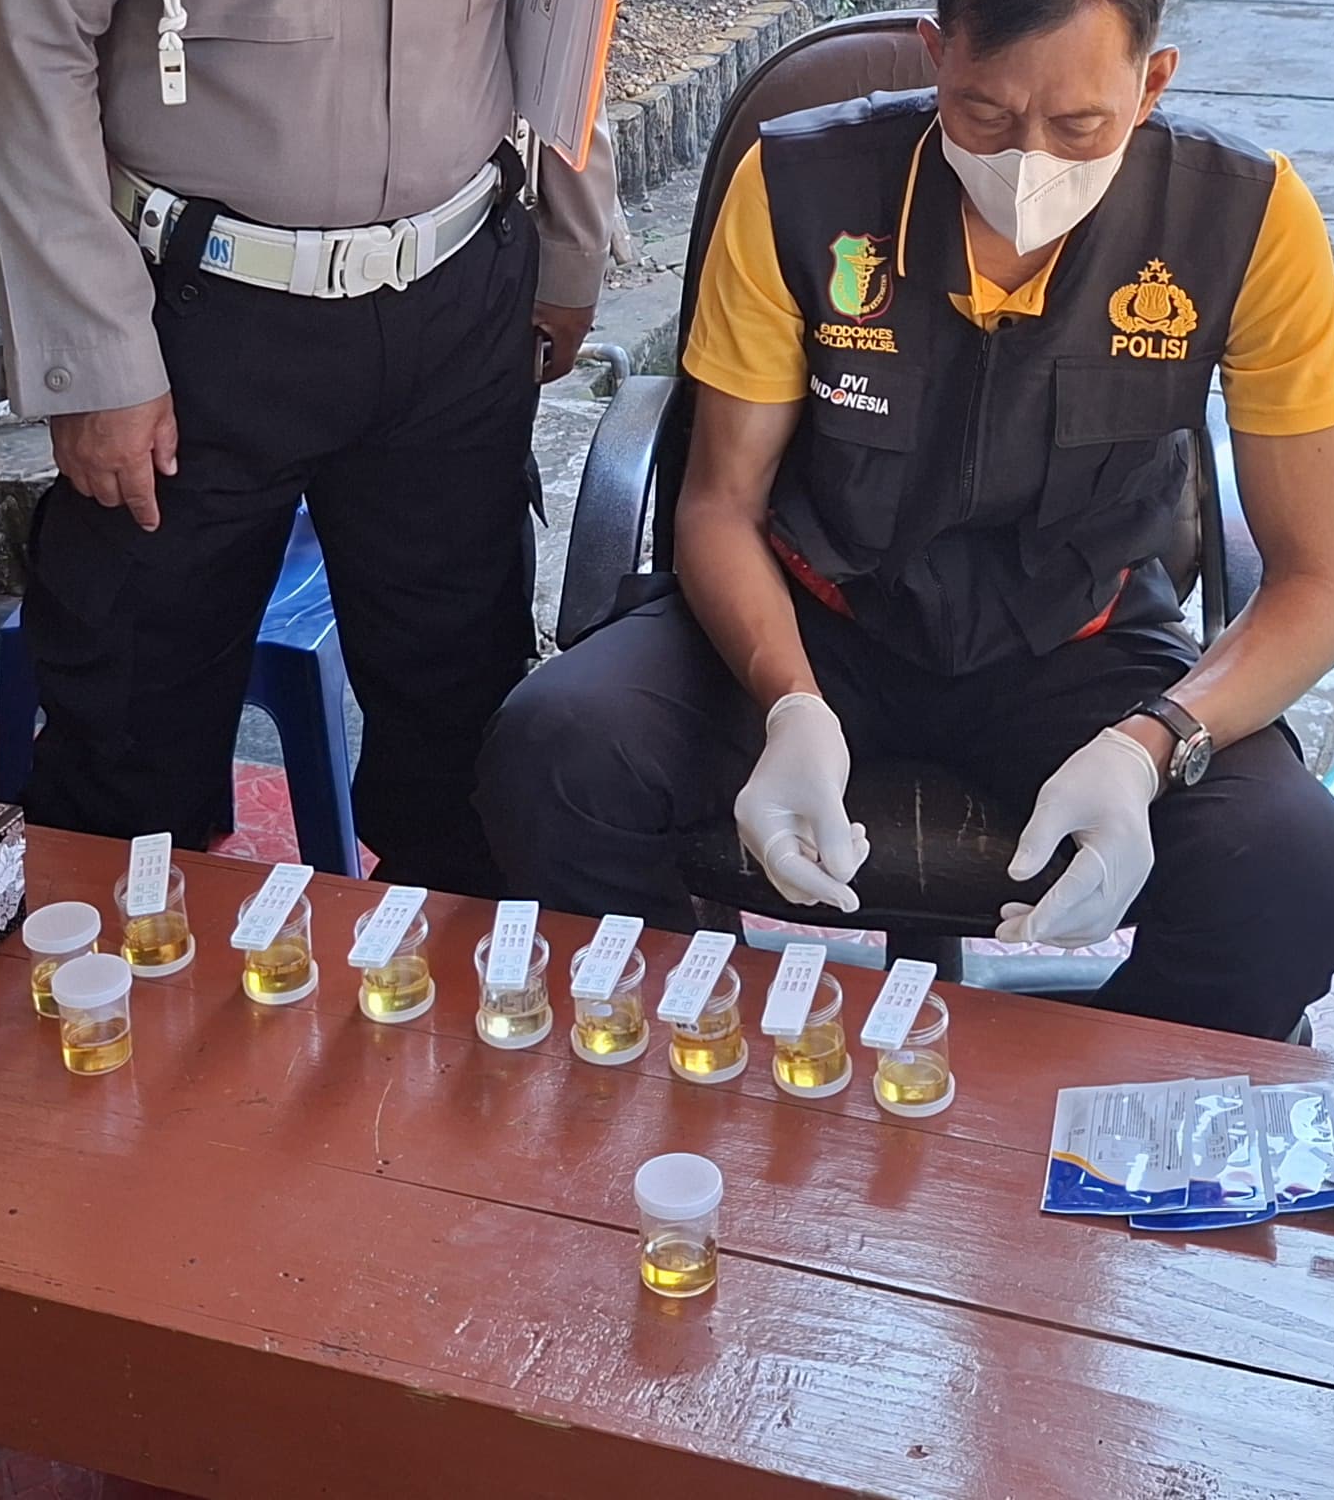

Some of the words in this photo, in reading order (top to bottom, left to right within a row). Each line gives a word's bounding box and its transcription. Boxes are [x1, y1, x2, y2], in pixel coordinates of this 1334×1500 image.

[1110, 334, 1188, 360] POLISI
[810, 374, 889, 415] INDONESIA
[840, 373, 869, 394] DVI
